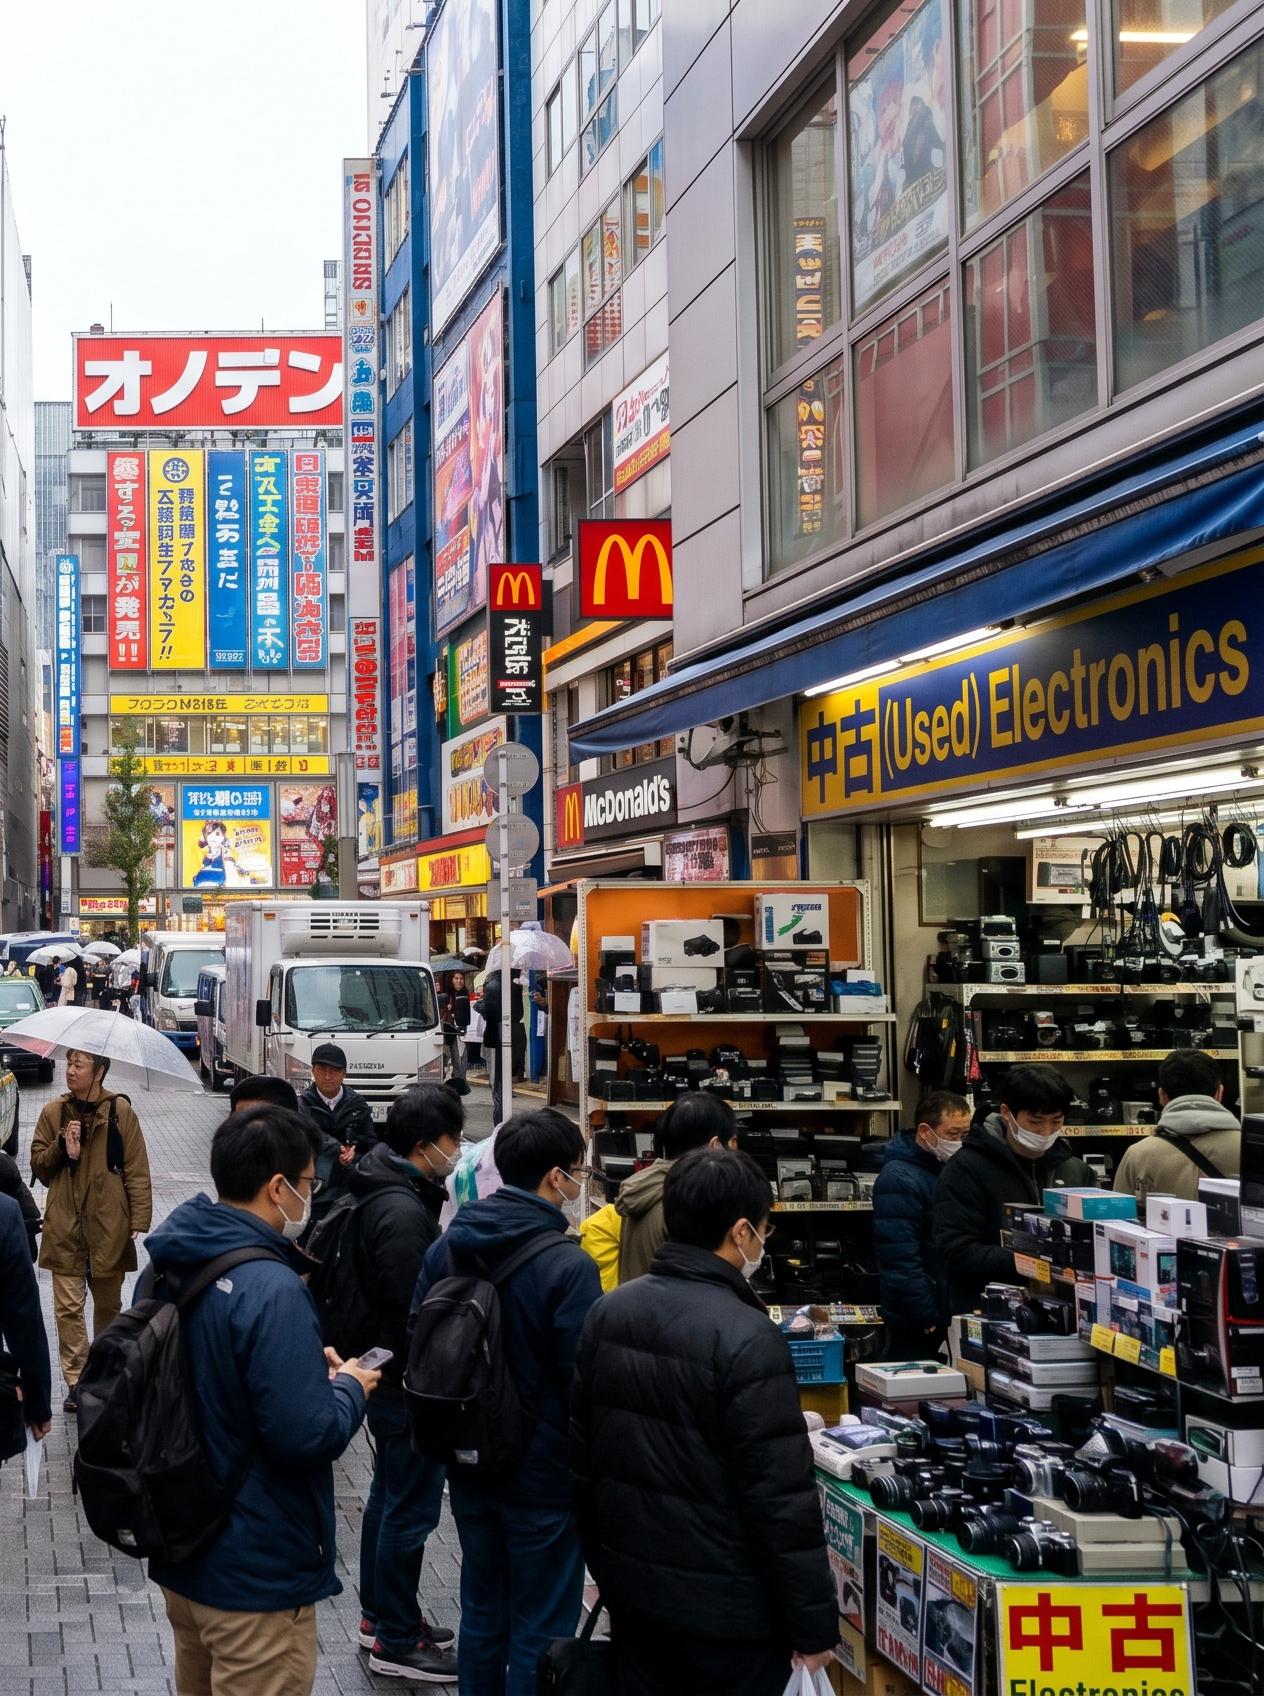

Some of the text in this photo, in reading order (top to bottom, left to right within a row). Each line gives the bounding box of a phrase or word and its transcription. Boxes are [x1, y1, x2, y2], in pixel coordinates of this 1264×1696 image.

[84, 348, 343, 415] オノデン
[807, 612, 1250, 804] 中古 (Used) Electronics
[584, 775, 671, 828] McDonald's
[1008, 1592, 1183, 1673] 中古
